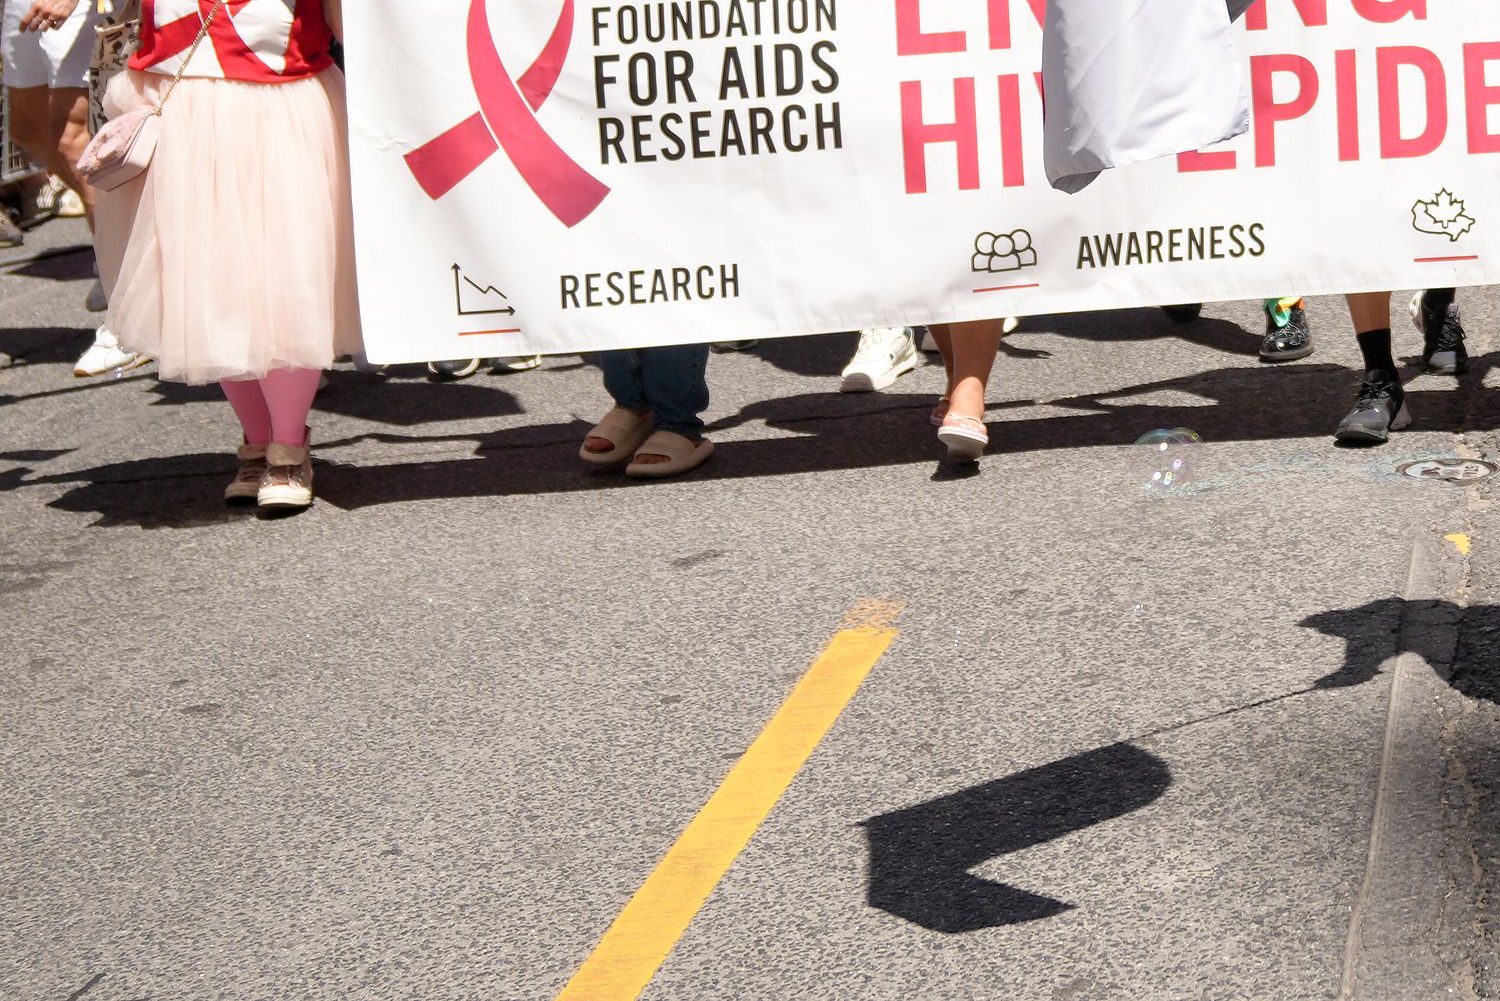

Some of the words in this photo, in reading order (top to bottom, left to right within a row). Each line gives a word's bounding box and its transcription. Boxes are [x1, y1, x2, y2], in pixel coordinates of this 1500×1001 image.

[593, 50, 698, 109] FOR
[718, 40, 840, 101] AIDS
[598, 102, 843, 164] RESEARCH
[900, 70, 1046, 194] HI
[1076, 222, 1266, 270] AWARENESS
[560, 263, 740, 310] RESEARCH
